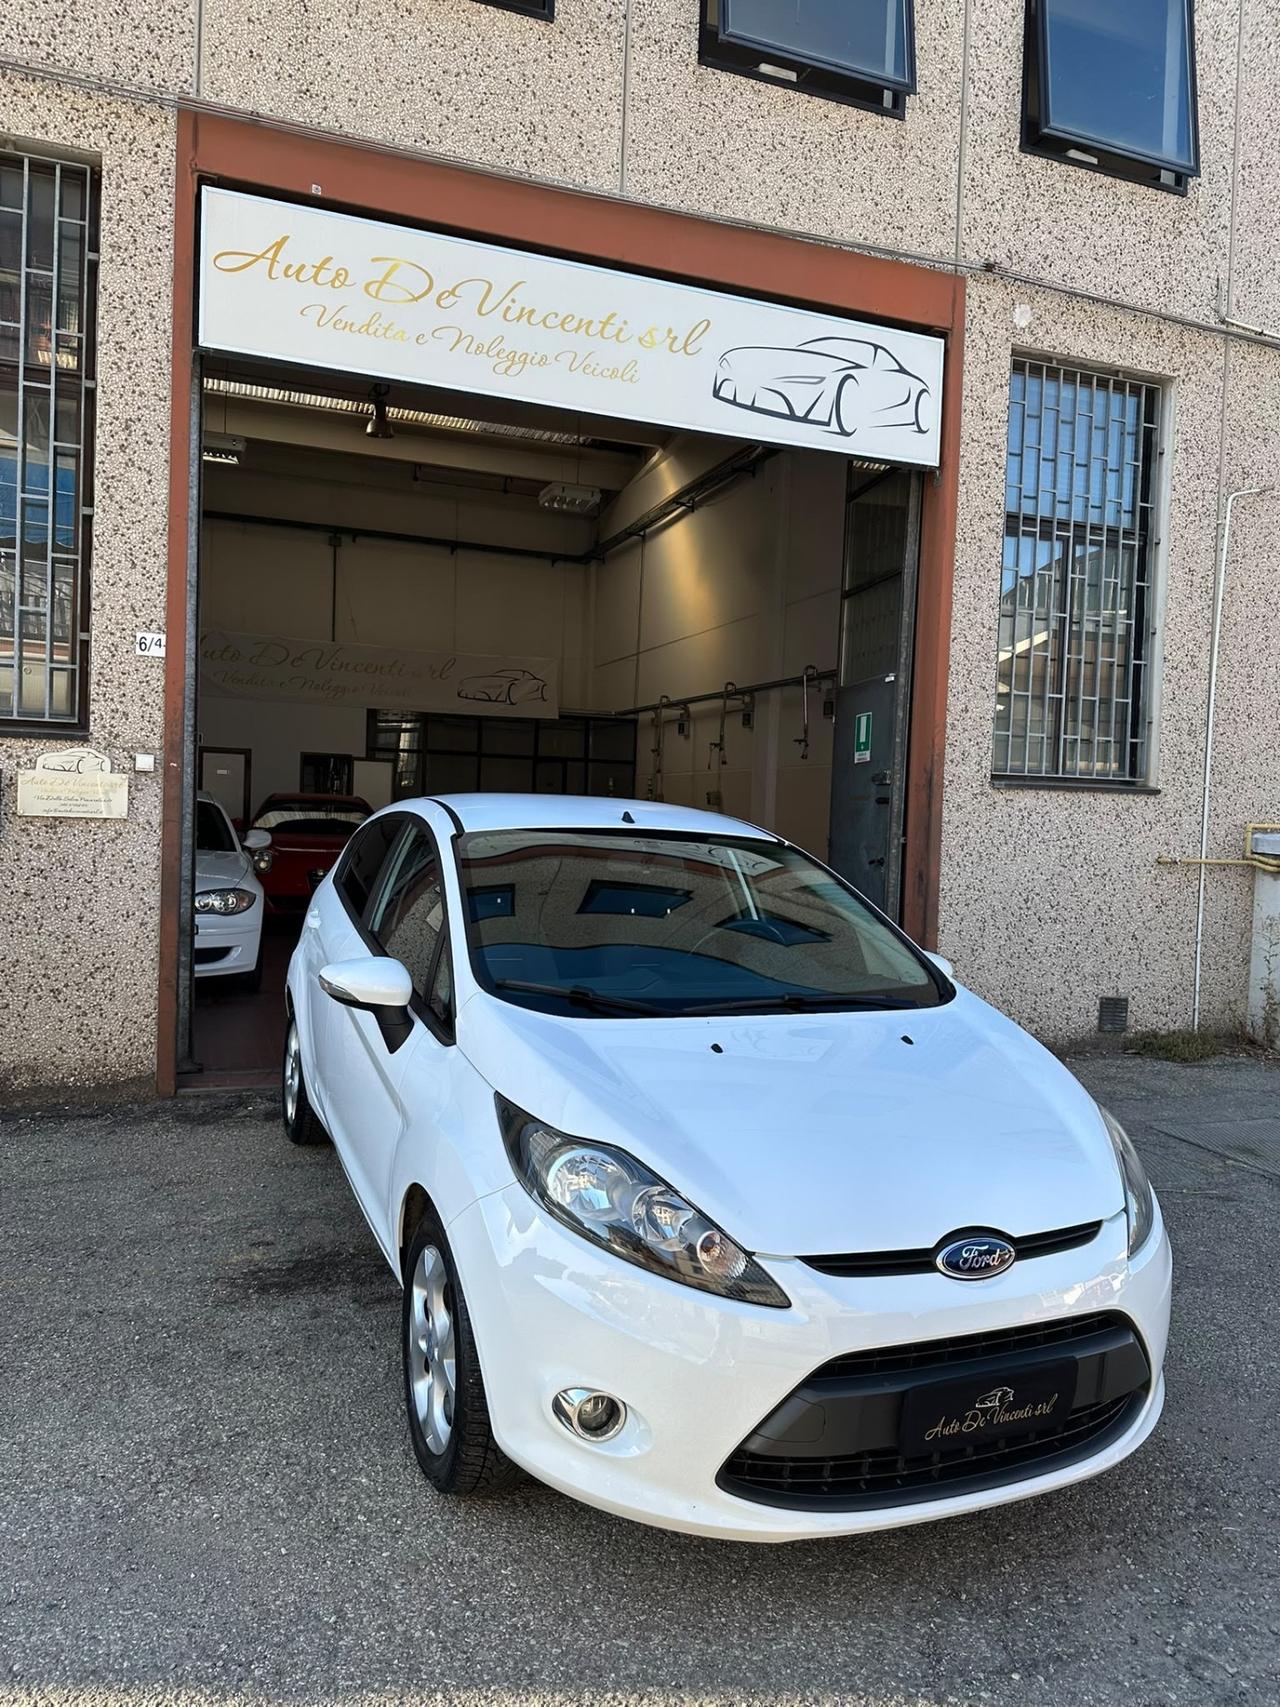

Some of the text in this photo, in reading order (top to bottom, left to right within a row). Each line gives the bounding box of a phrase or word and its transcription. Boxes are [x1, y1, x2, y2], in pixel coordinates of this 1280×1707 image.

[213, 235, 711, 356] Auto De Vincenti srl
[299, 303, 640, 384] Vendita e Noleggio Veicoli
[138, 636, 162, 652] 6/4
[199, 635, 243, 662] uto
[960, 1245, 1001, 1270] Ford
[924, 1416, 960, 1440] Auto
